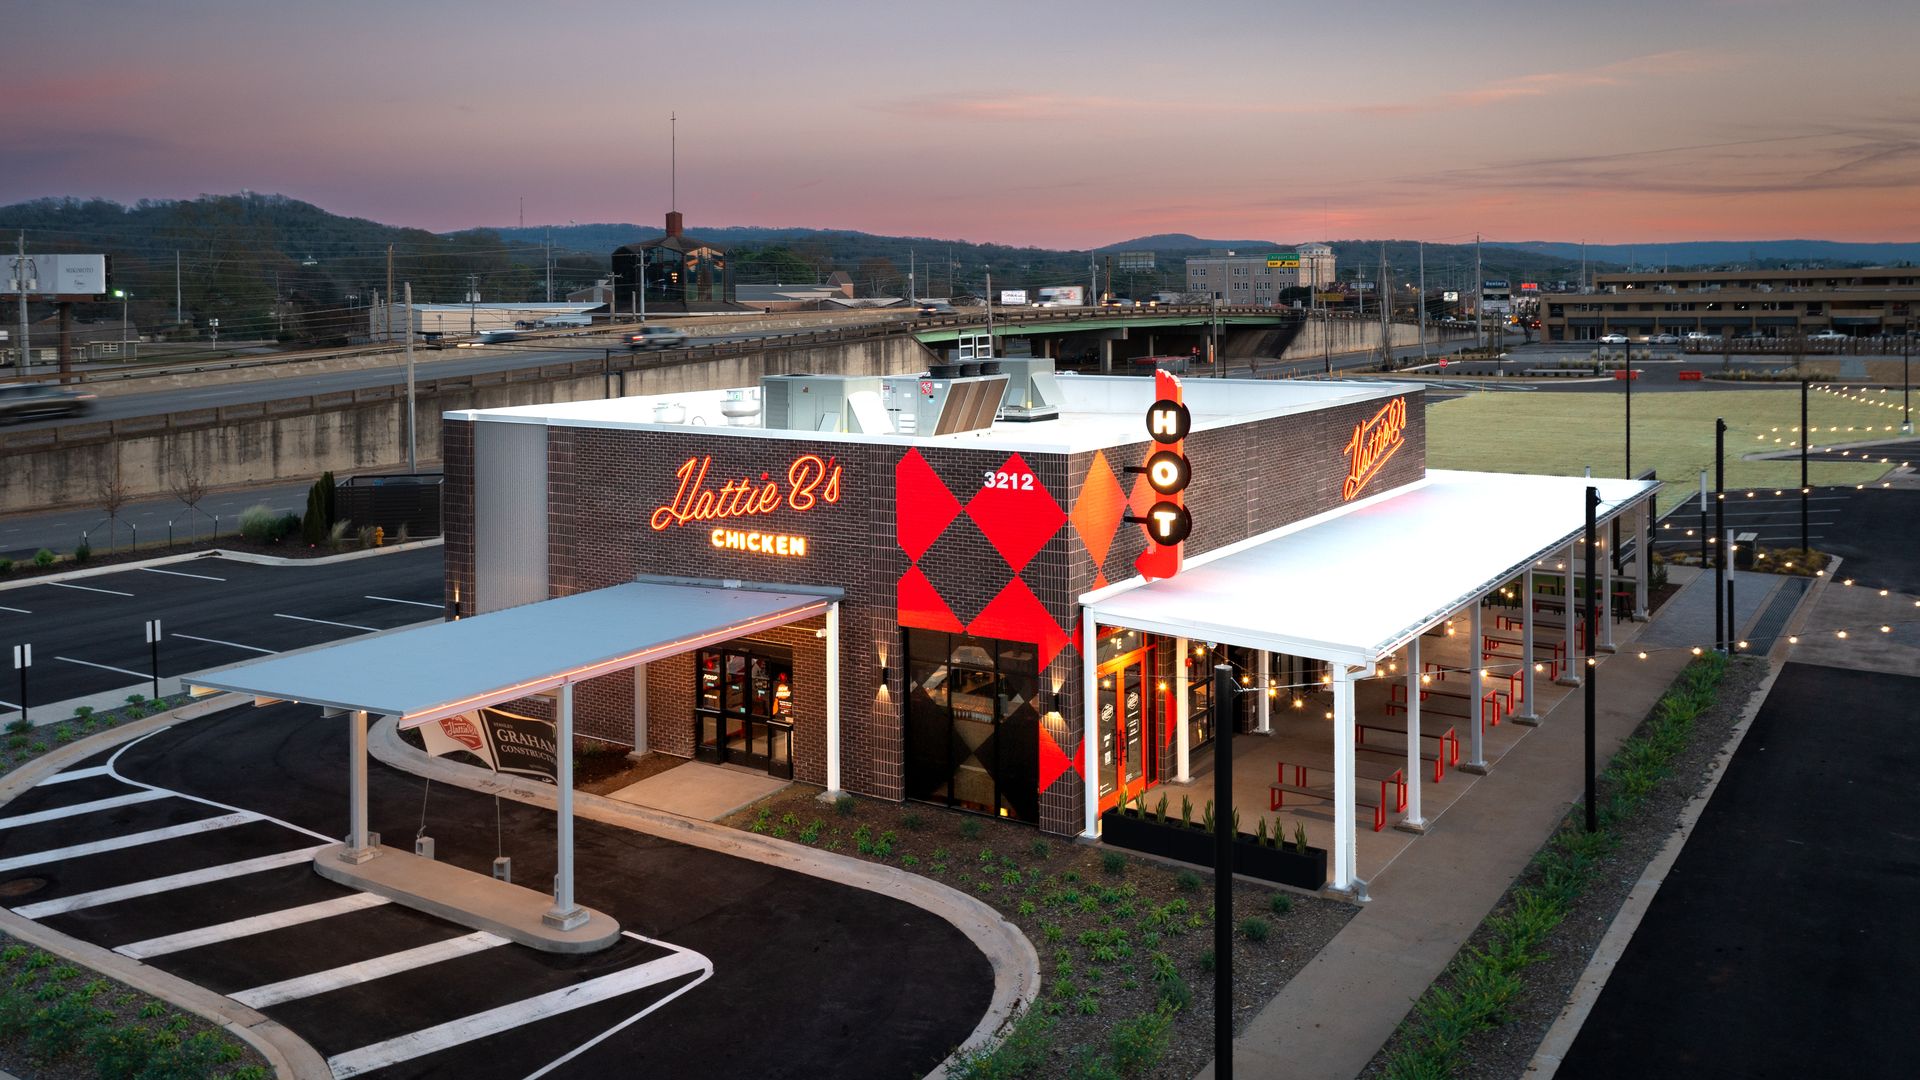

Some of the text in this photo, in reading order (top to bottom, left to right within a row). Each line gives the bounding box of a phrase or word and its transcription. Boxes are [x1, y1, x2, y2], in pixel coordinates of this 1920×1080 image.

[650, 453, 843, 532] Hattie B's
[983, 471, 1035, 491] 3212
[711, 528, 806, 557] CHICKEN
[496, 728, 556, 757] GRAHAM
